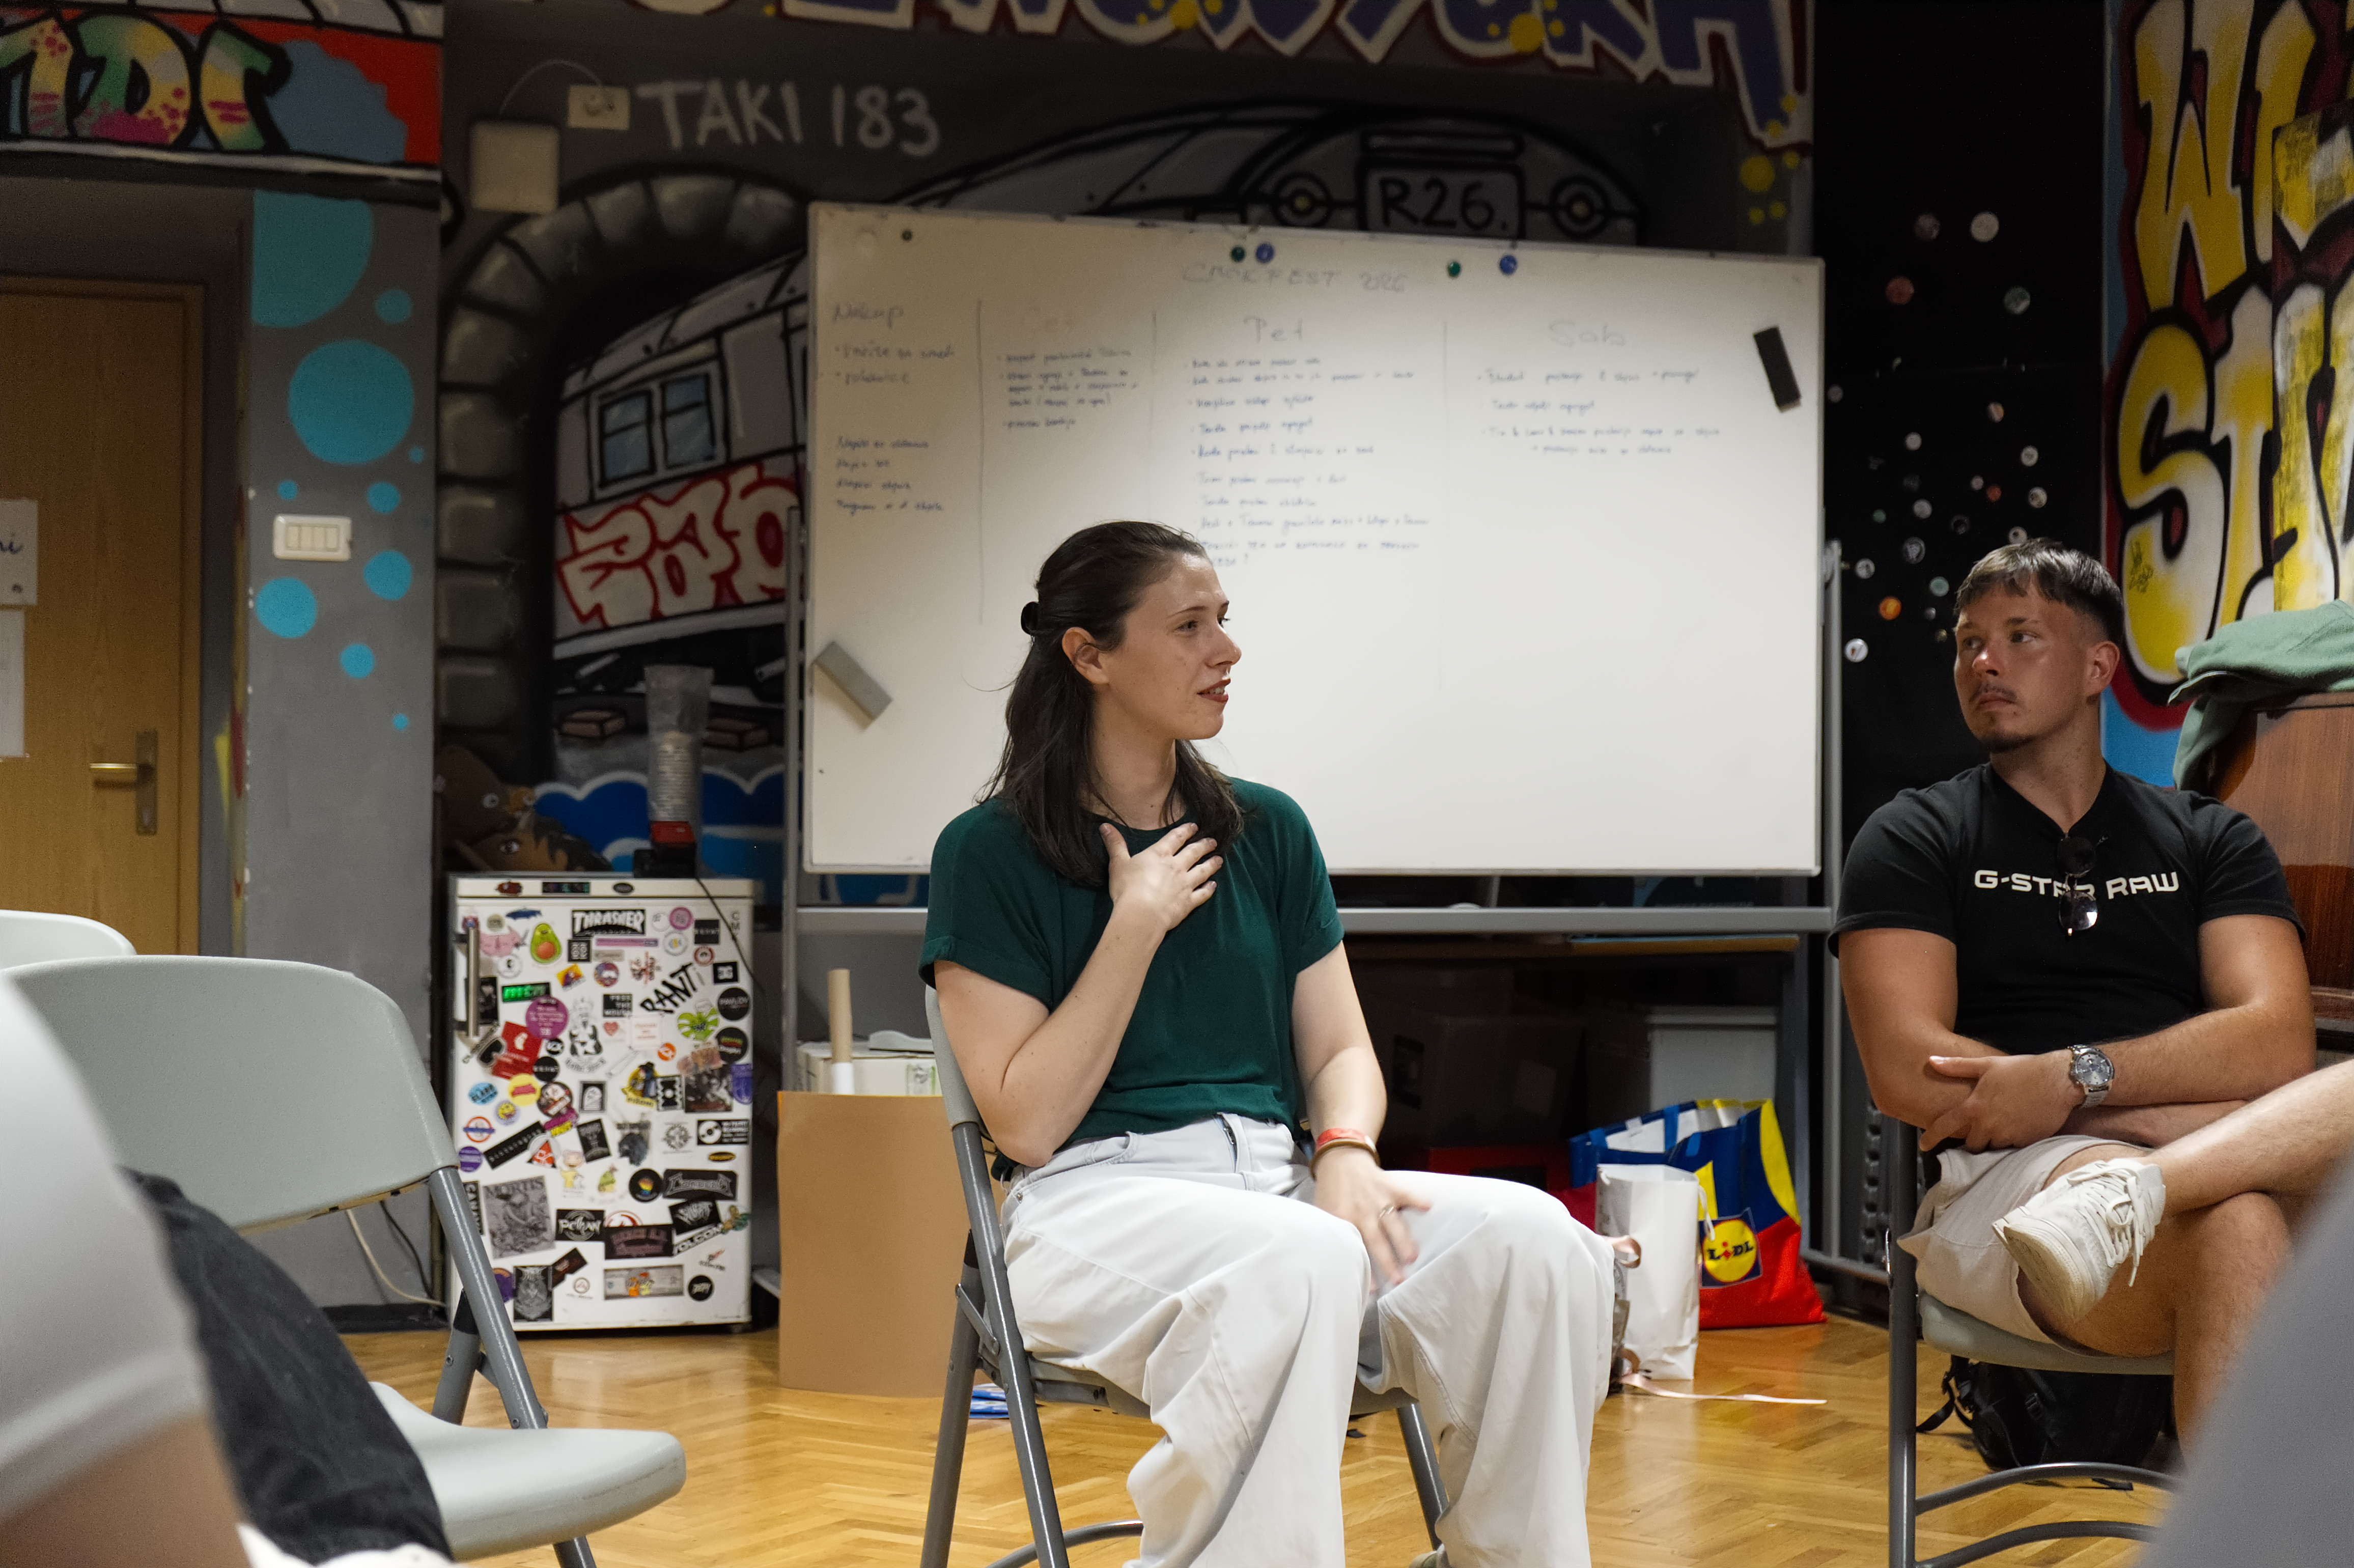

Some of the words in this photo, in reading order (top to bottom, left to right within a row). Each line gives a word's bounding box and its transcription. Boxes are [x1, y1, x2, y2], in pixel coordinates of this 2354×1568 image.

[636, 78, 803, 150] TAKI
[831, 83, 941, 157] 183
[2105, 871, 2179, 900] RAW
